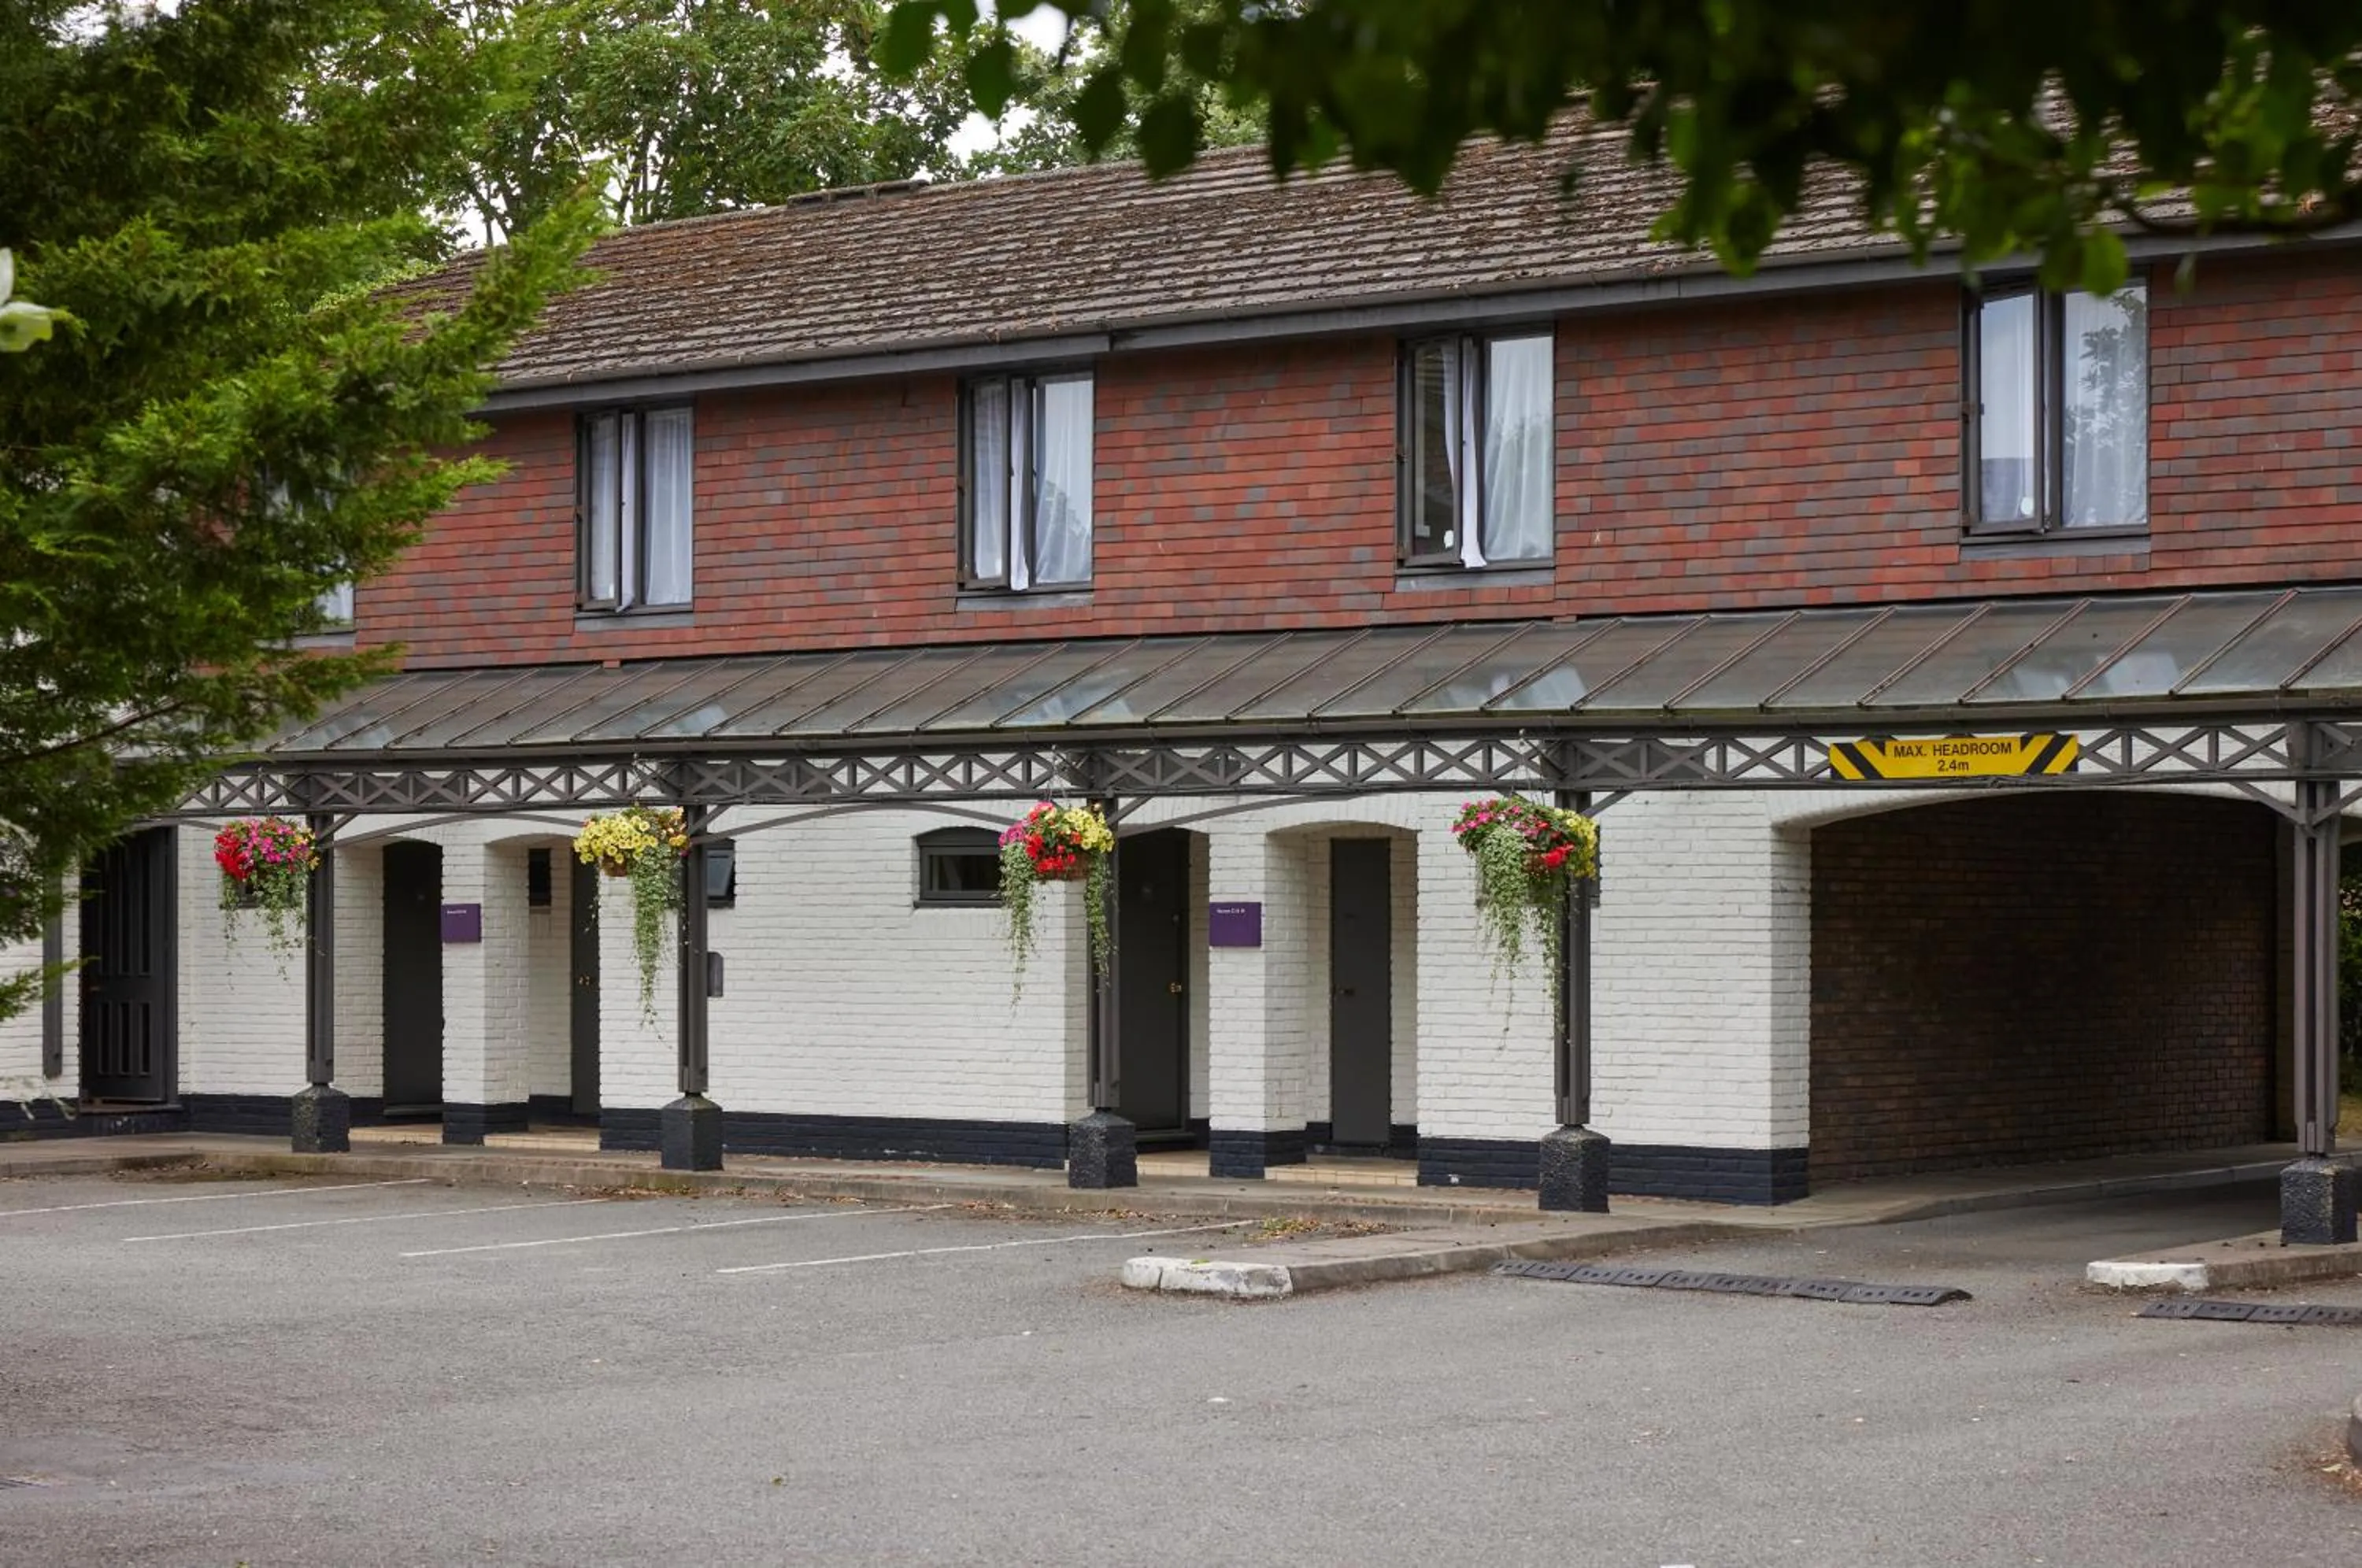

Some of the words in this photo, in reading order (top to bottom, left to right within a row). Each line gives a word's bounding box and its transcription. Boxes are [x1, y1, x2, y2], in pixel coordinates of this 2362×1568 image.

[1894, 745, 1927, 757] MAX.
[1933, 742, 2012, 756] HEADROOM
[1938, 760, 1969, 771] 2.4m
